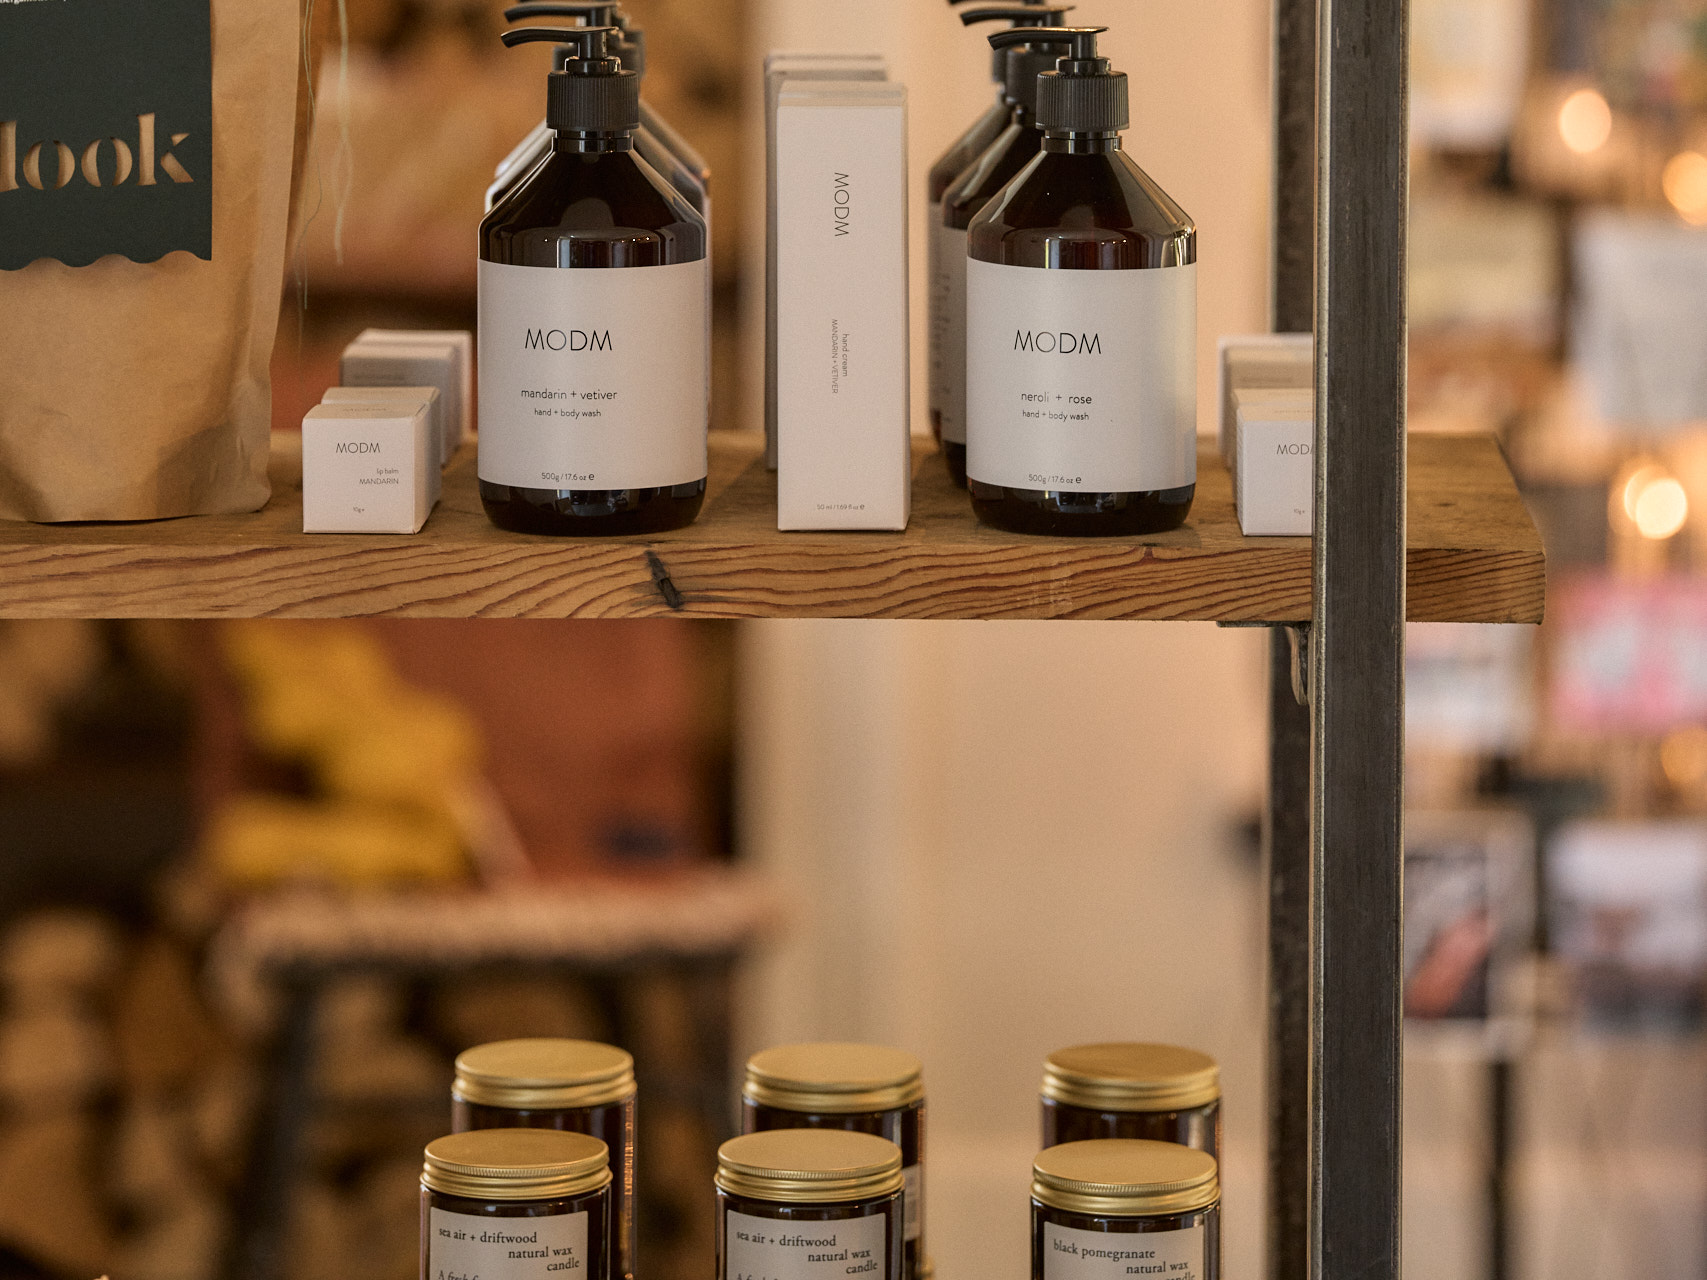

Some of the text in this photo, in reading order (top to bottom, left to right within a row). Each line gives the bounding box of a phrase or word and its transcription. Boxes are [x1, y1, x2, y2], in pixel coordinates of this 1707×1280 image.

[834, 172, 850, 237] MODM
[524, 328, 613, 352] MODM
[842, 333, 850, 352] hand
[1013, 329, 1101, 354] MODM
[521, 388, 617, 400] mandarin + vetiver
[1021, 391, 1049, 402] neroli
[1068, 396, 1092, 404] rose
[534, 408, 602, 420] hand body wash
[1022, 410, 1089, 422] hand body wash
[335, 442, 380, 454] MODM
[1276, 444, 1313, 455] MOD
[439, 1228, 450, 1238] sea
[453, 1230, 466, 1240] air
[480, 1231, 537, 1243] driftwood
[736, 1231, 749, 1241] sea
[752, 1233, 766, 1244] air
[779, 1235, 836, 1247] driftwood
[508, 1246, 573, 1258] natural wax
[808, 1249, 871, 1262] natural wax
[1053, 1239, 1156, 1262] black pomegranate
[547, 1257, 580, 1271] candle
[846, 1260, 878, 1274] candle
[1126, 1261, 1189, 1274] natural wax
